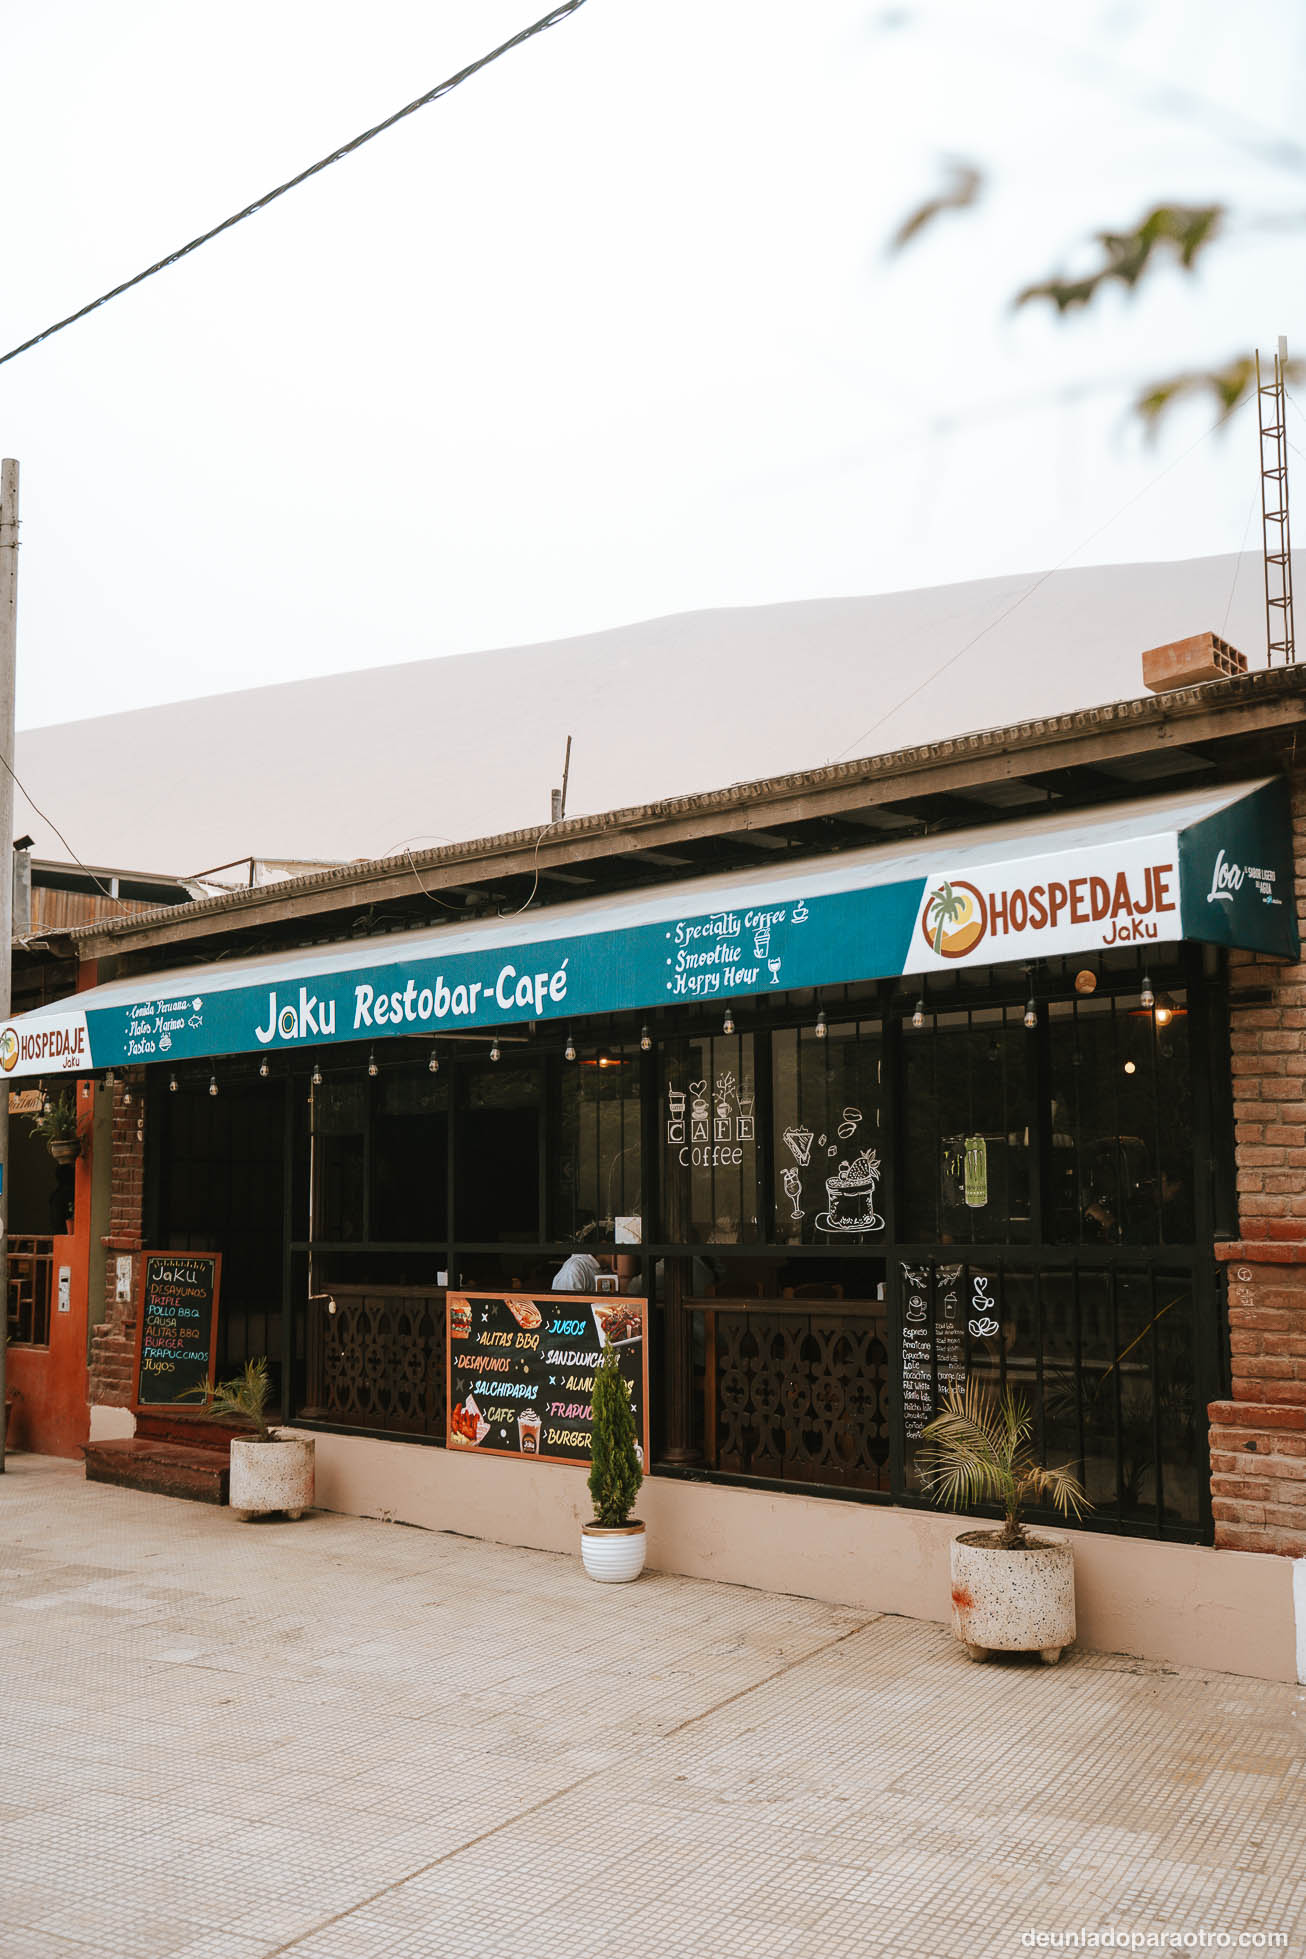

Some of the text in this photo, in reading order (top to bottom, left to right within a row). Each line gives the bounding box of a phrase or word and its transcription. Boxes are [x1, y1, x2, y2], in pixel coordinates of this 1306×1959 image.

[1207, 849, 1244, 902] Loa
[989, 864, 1176, 937] HOSPEDAJE
[674, 910, 786, 948] Specialty Coffee
[675, 943, 742, 972] Smoothie
[673, 966, 760, 996] Happy Hour
[254, 986, 336, 1044] Jaku
[129, 1016, 184, 1036] Platos Marinos
[21, 1027, 84, 1060] HOSPEDAJE
[128, 1037, 156, 1056] Pastas
[150, 1294, 181, 1306] TRIPLE
[151, 1284, 207, 1298] DESAYUNOS
[148, 1304, 200, 1318] POLLO BBQ
[146, 1316, 177, 1327] CAUSA
[549, 1320, 586, 1336] JUGOS
[145, 1336, 184, 1348] BURGER
[146, 1326, 200, 1339] ALITAS BBQ
[480, 1331, 540, 1352] ALITAS BBQ
[458, 1354, 512, 1374] DESAYUNOS
[474, 1380, 538, 1400] SALCHIPAPAS
[487, 1406, 516, 1424] CAFE
